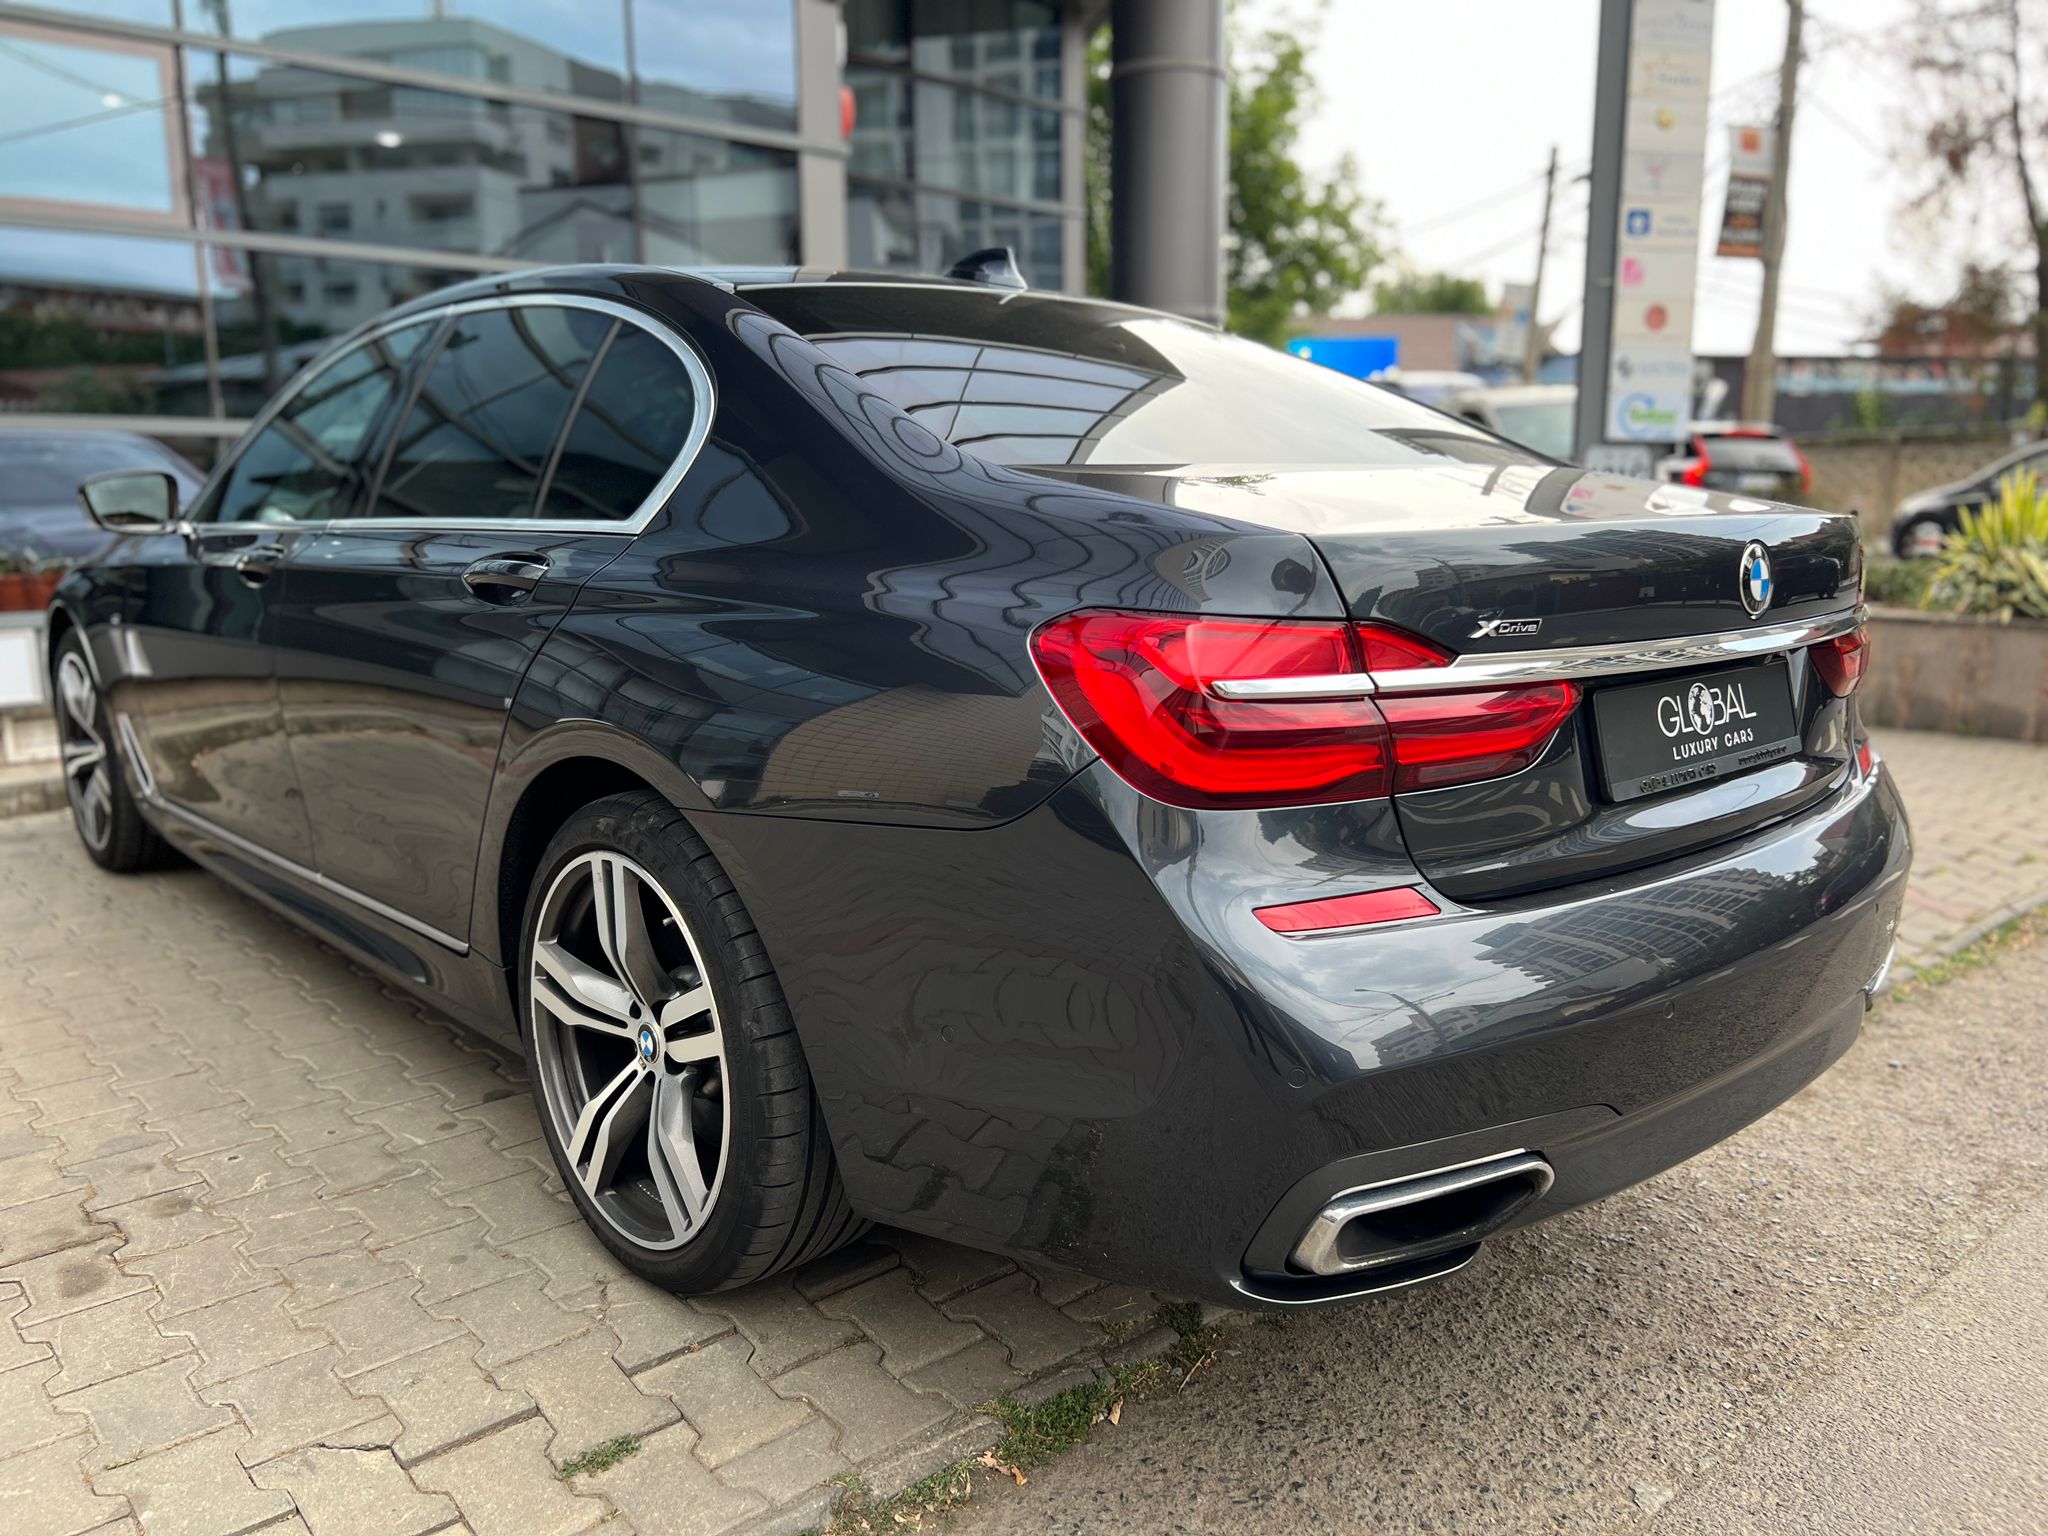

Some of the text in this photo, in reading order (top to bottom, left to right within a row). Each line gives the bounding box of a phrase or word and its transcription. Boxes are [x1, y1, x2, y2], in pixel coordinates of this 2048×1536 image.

[1657, 683, 1757, 737] GLOBAL
[1673, 736, 1718, 760] LUXURY
[1724, 728, 1754, 747] CARS
